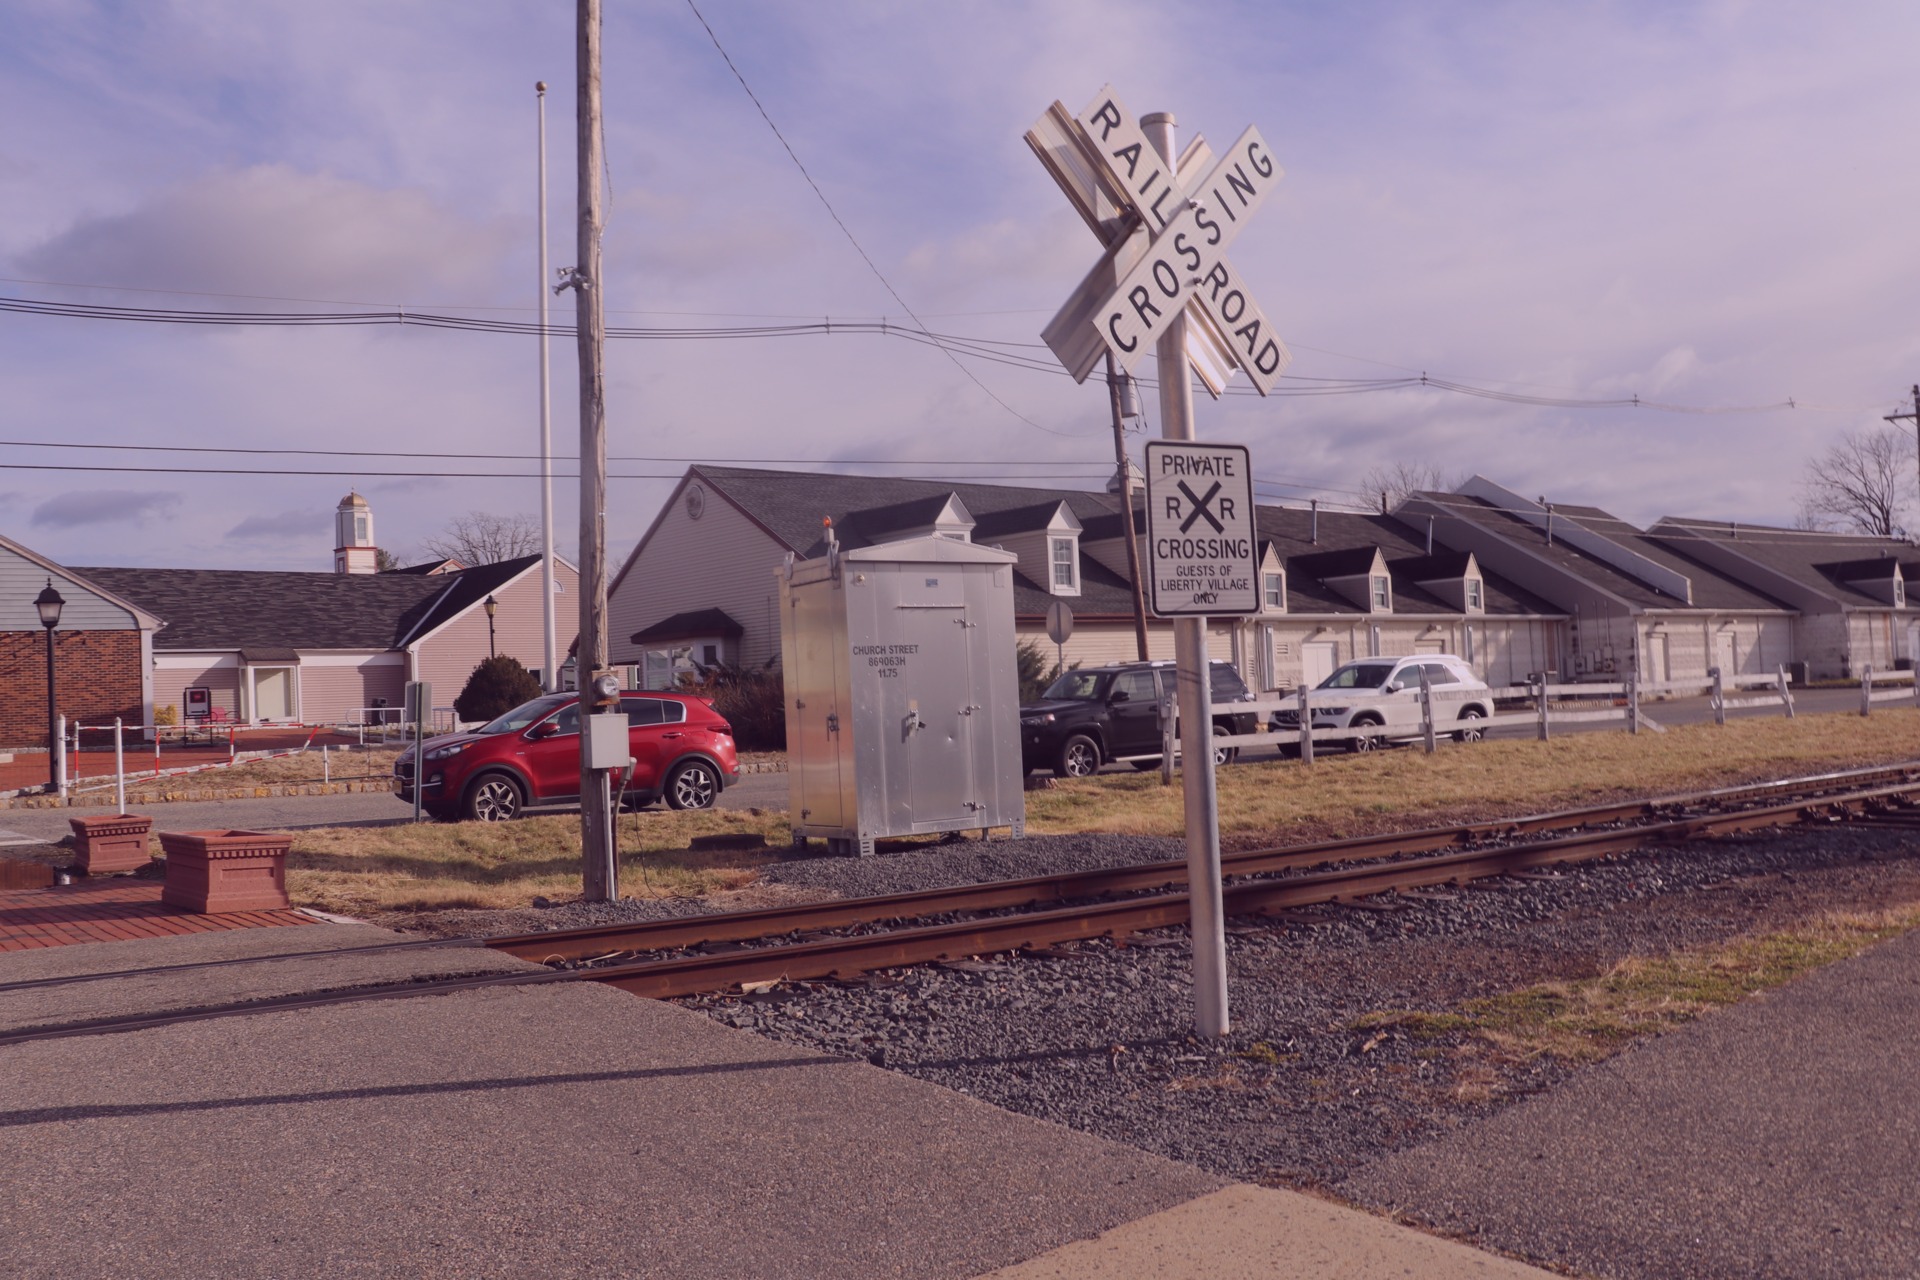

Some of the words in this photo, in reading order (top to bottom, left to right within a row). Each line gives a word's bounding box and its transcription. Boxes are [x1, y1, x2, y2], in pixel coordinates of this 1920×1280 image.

[1109, 142, 1273, 353] CROSSING
[1162, 454, 1235, 476] PRIVATE
[1157, 539, 1249, 559] CROSSING
[1176, 565, 1215, 577] GUESTS
[1219, 565, 1232, 576] OF
[1161, 579, 1202, 591] LIBERTY
[1208, 579, 1249, 590] VILLAGE
[1193, 593, 1218, 604] ONLY
[852, 645, 886, 655] CHURCH
[888, 644, 919, 654] STREET
